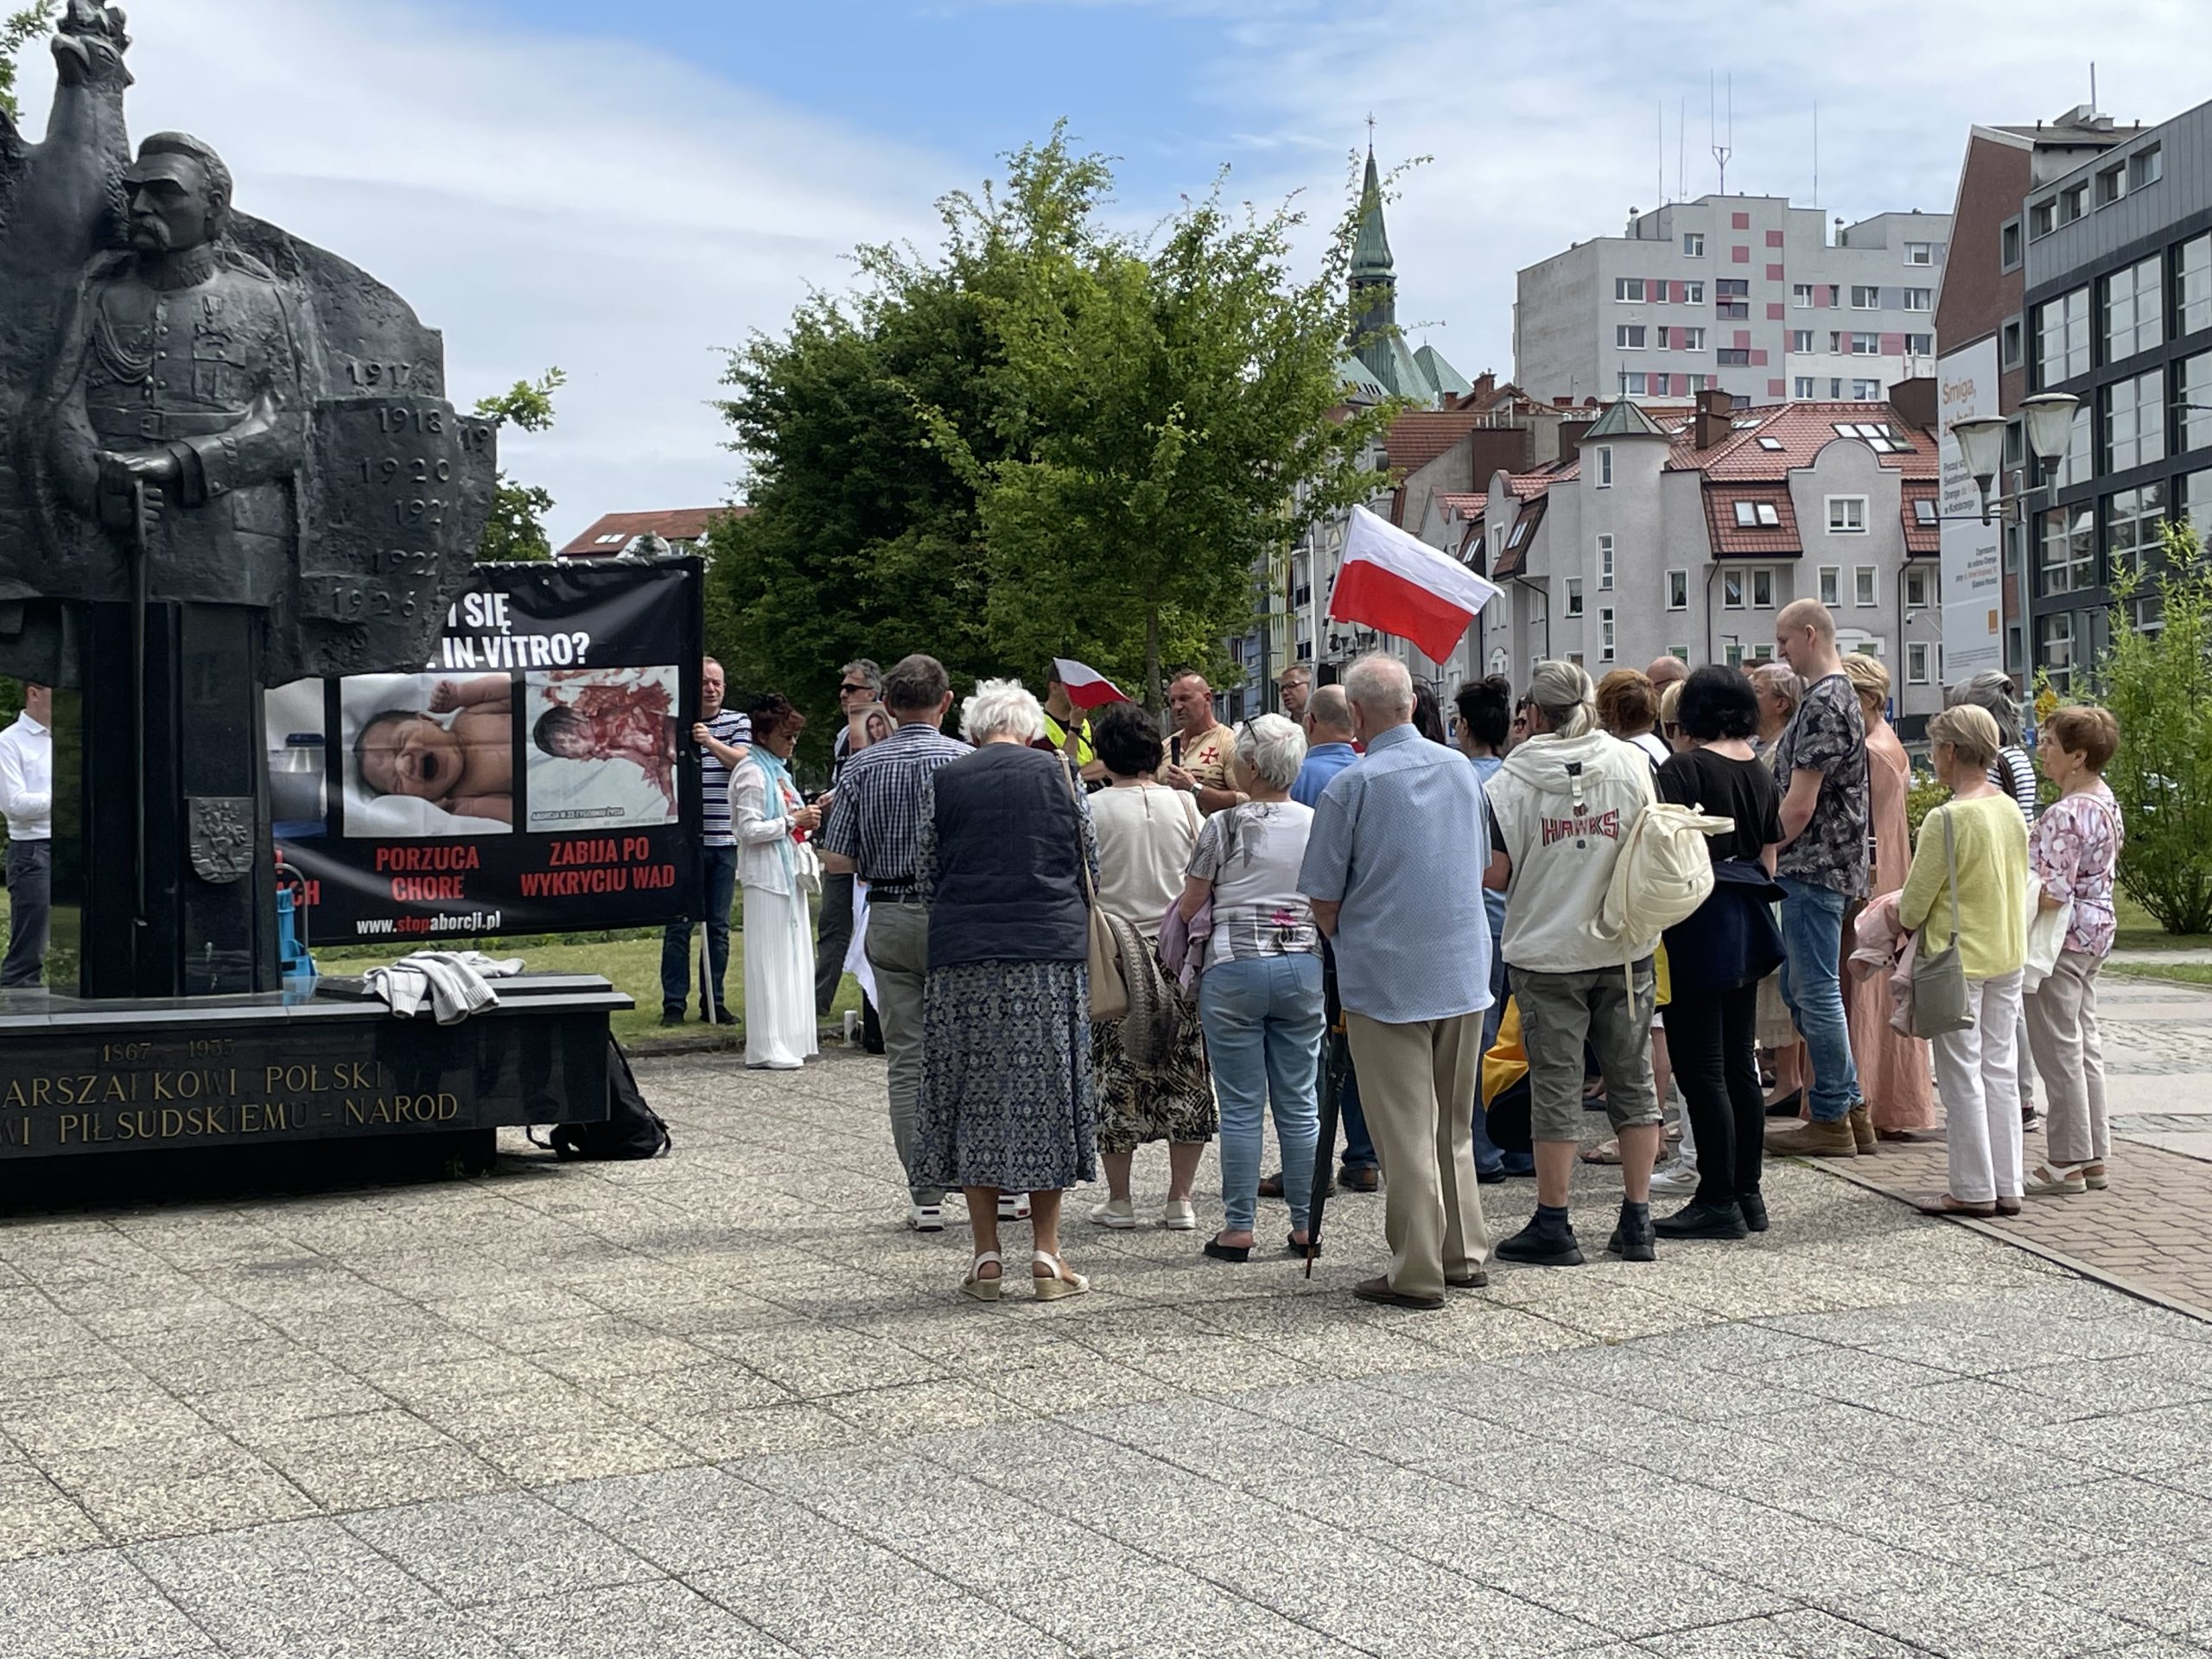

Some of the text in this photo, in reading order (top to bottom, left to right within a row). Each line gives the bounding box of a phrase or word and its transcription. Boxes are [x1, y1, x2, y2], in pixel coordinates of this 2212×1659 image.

[346, 361, 411, 386] 1917
[1942, 376, 1977, 404] Śmiga,
[378, 407, 443, 434] 1918
[362, 457, 450, 482] 1920
[333, 587, 416, 619] 1926
[463, 592, 512, 635] SIĘ
[442, 632, 590, 669] IN-VITRO?
[1541, 807, 1620, 847] HAWKS
[376, 846, 480, 872] PORZUCA
[550, 836, 650, 867] ZABIJA PO
[391, 875, 465, 901] CHORE
[520, 865, 676, 897] WYKRYCIU WAD
[356, 910, 501, 935] www.stopaborcji.pl
[102, 1041, 152, 1062] 1867
[188, 1038, 235, 1059] 1935
[265, 1059, 383, 1095] POLSKI
[58, 1100, 309, 1145] PIŁSUDSKIEMU
[345, 1092, 458, 1124] NAROD
